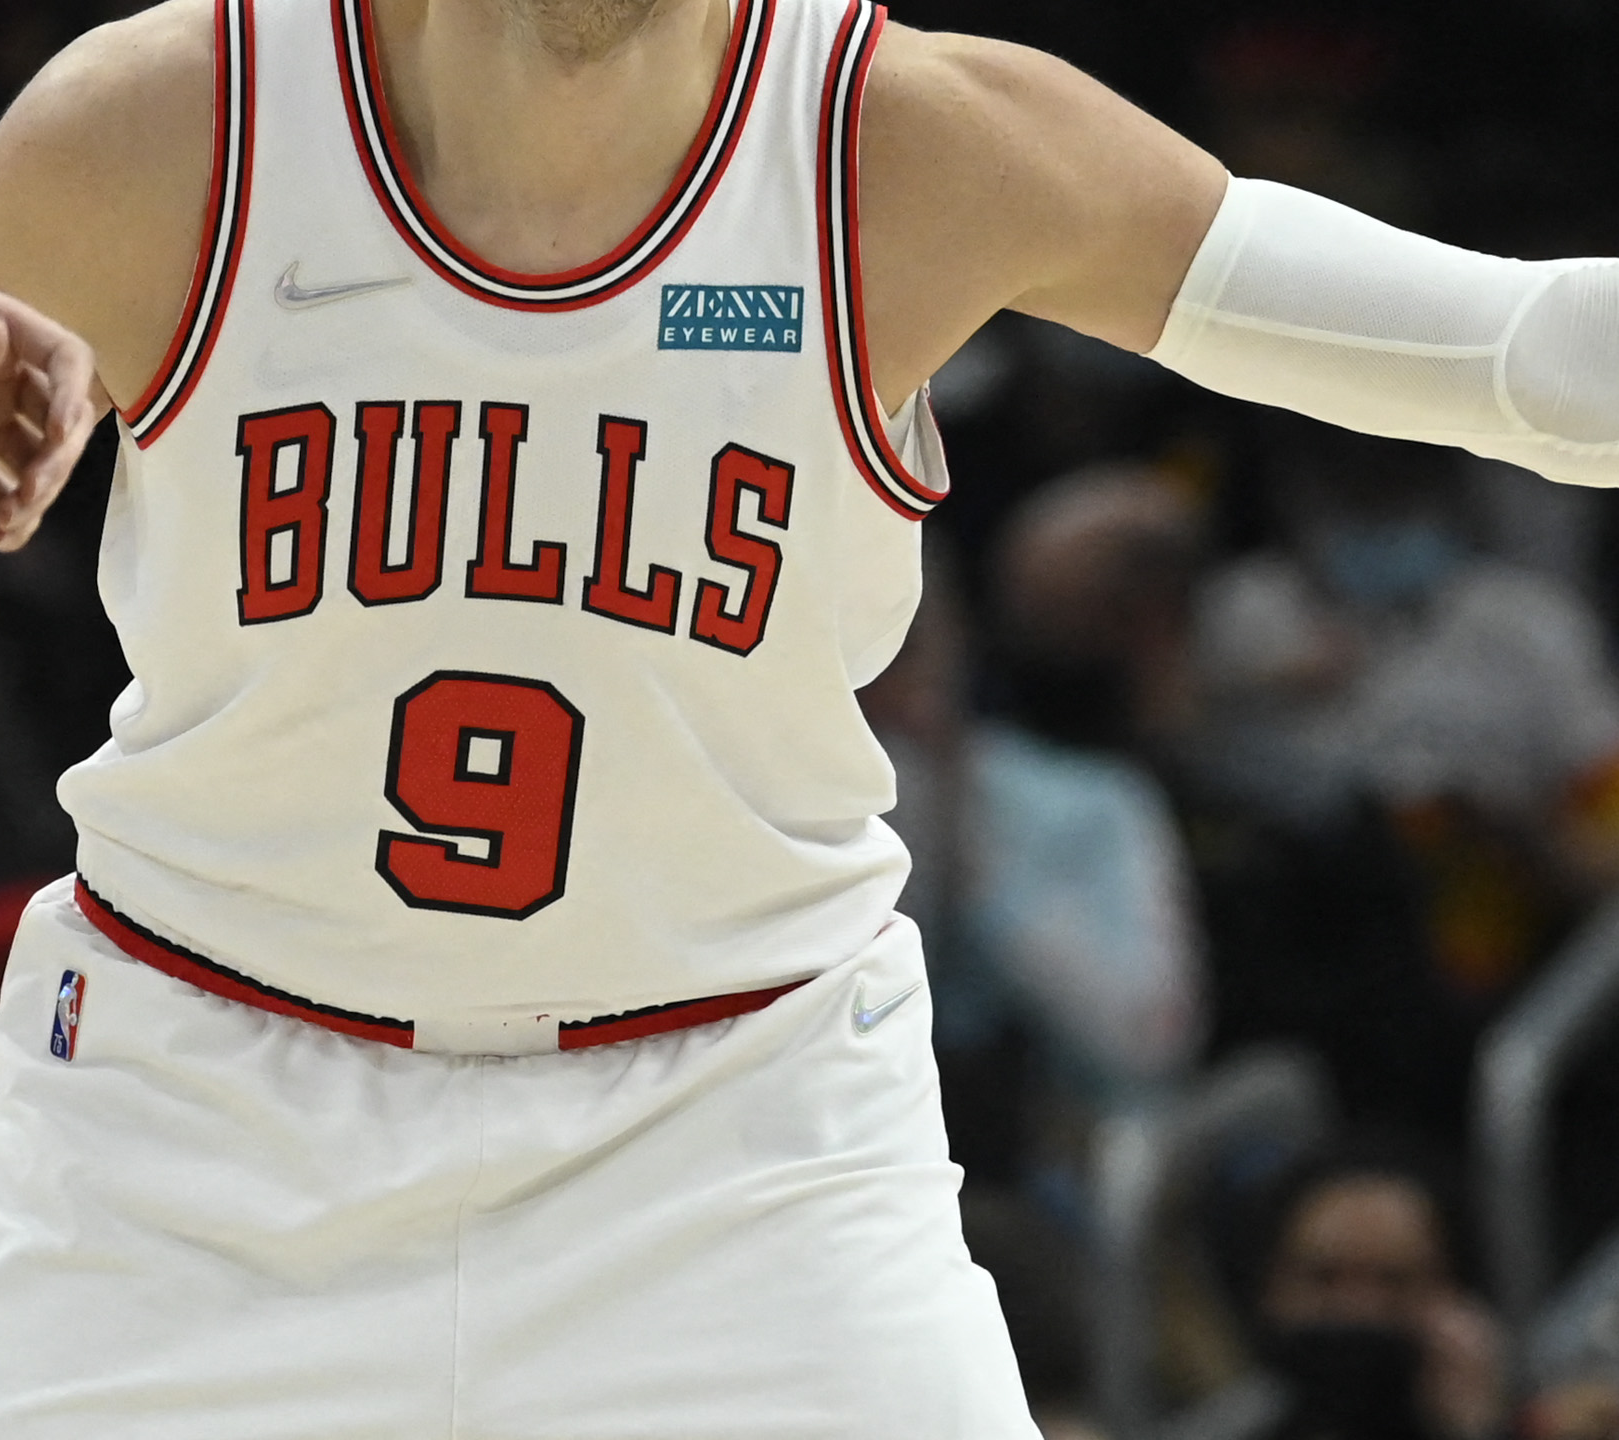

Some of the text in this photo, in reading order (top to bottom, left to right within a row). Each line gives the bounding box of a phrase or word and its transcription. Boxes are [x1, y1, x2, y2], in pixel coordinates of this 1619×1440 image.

[664, 327, 797, 344] EYEWEAR
[666, 290, 799, 319] ZENNI
[235, 400, 795, 657] BULLS
[375, 670, 586, 921] 9
